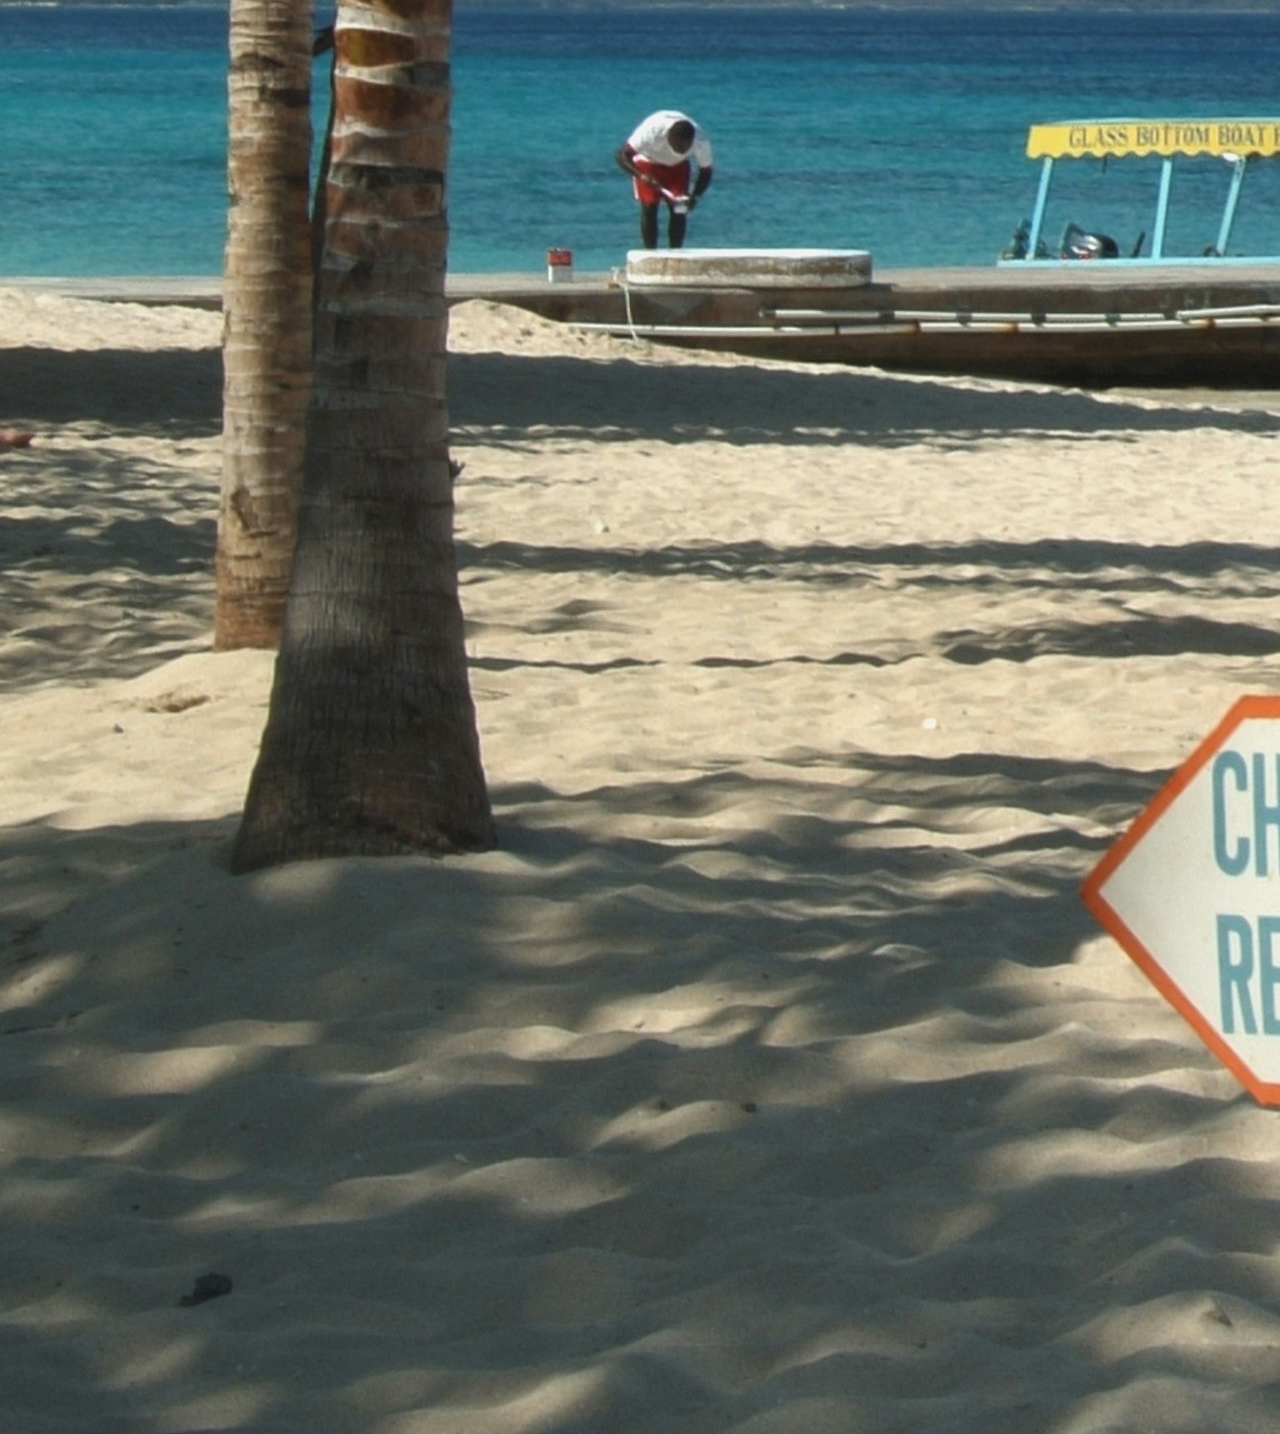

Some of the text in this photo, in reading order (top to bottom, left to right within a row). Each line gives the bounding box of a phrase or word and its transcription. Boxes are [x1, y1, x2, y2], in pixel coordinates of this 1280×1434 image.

[1068, 125, 1128, 149] GLASS
[1135, 125, 1209, 146] BOTTOM
[1217, 124, 1266, 146] BOAT
